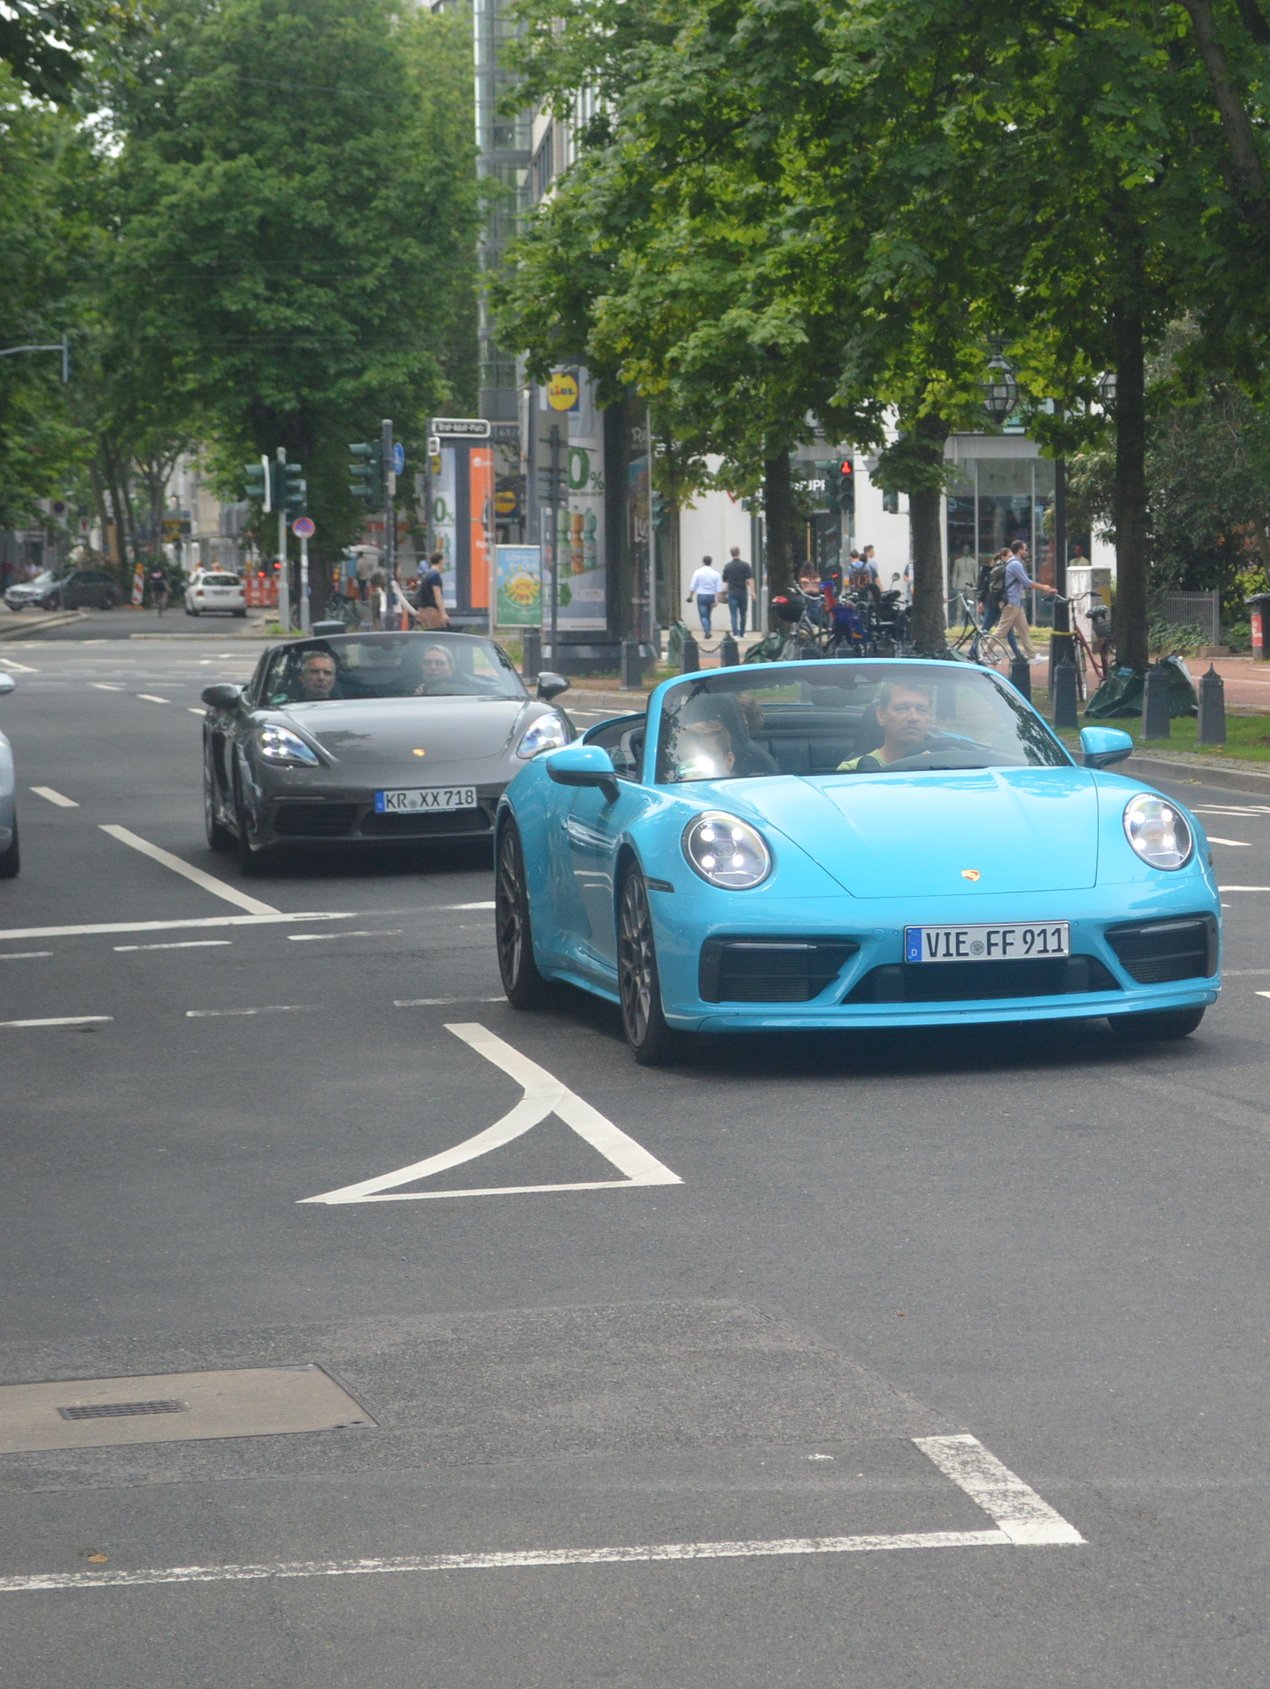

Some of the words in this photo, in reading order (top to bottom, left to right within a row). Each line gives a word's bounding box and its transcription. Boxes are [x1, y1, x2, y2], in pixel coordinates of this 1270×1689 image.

[385, 793, 407, 809] KR
[420, 792, 440, 808] XX
[444, 790, 474, 806] 718
[926, 931, 969, 957] VIE
[986, 929, 1016, 956] FF
[1022, 927, 1064, 955] 911
